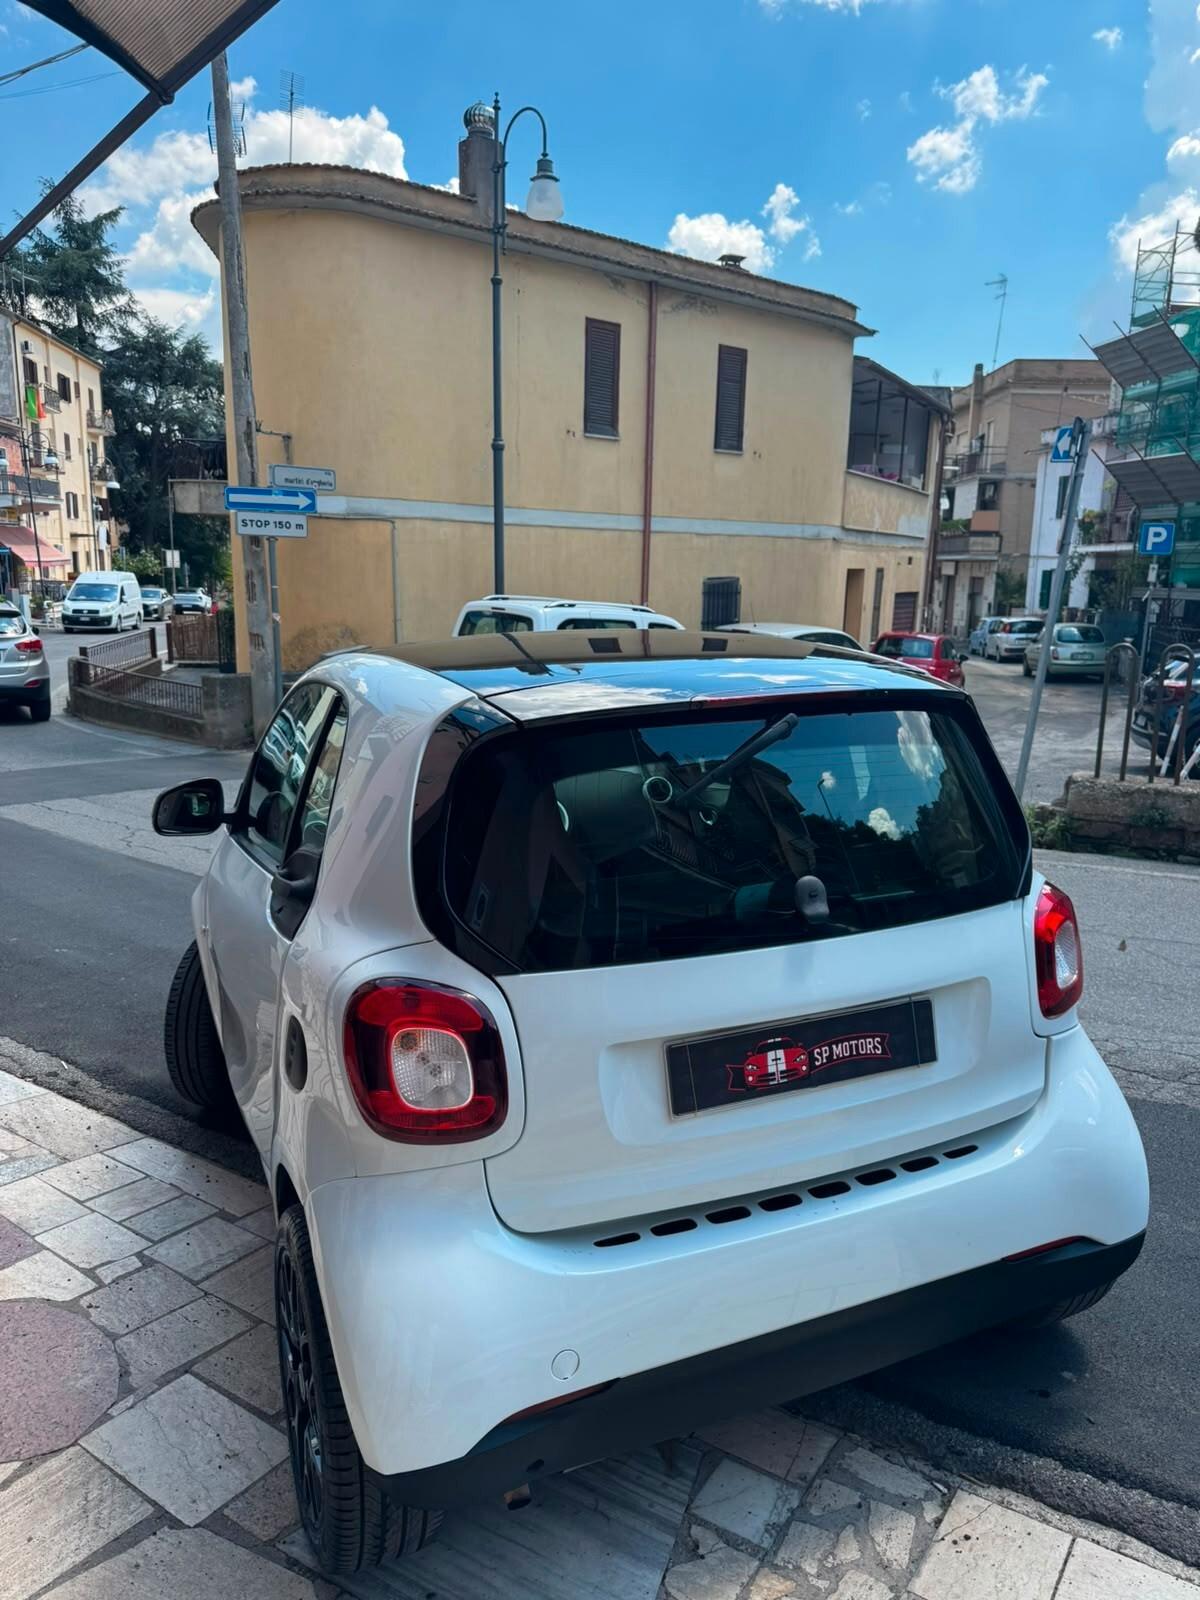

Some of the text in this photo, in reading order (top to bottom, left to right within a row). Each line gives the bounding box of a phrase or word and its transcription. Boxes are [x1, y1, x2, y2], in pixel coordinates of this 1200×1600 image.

[241, 519, 270, 528] STOP
[273, 520, 292, 529] 150
[1146, 526, 1168, 551] P
[813, 1037, 882, 1066] SP MOTORS
